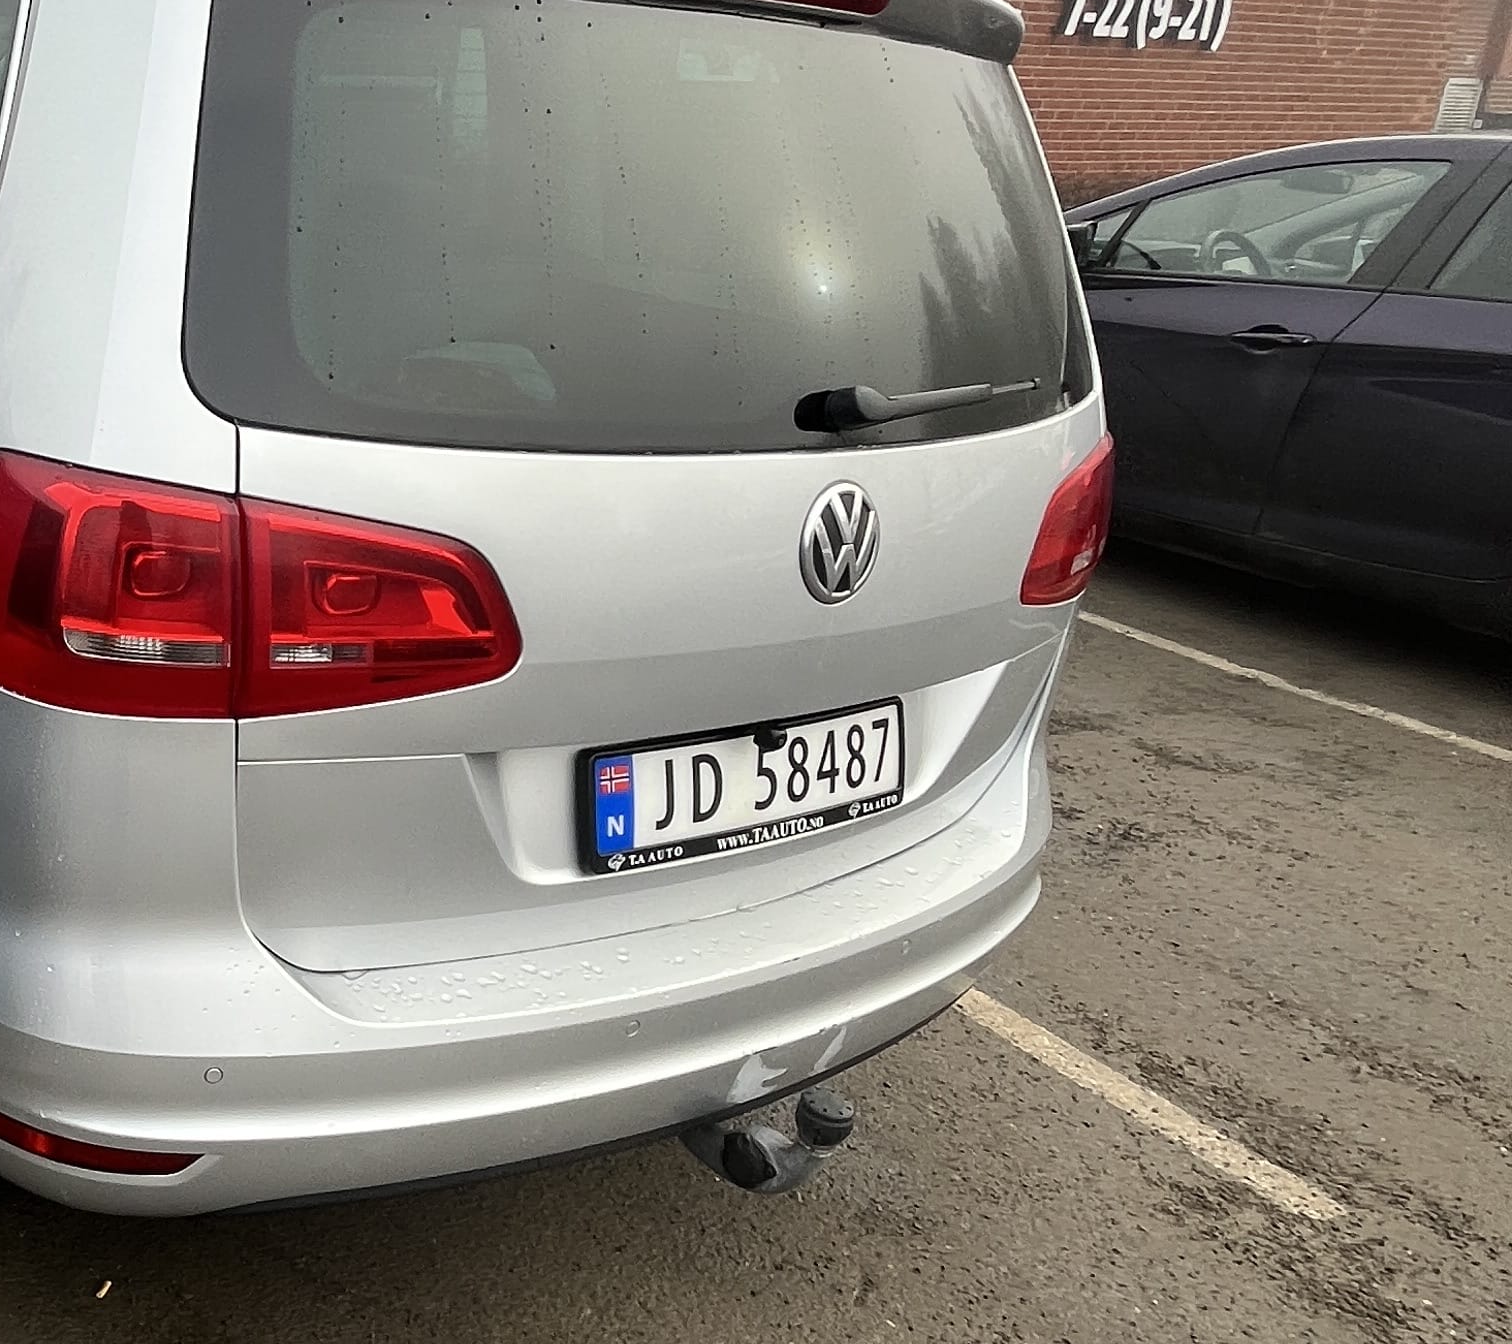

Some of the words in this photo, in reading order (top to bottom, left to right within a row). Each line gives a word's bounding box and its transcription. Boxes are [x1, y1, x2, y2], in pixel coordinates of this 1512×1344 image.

[655, 753, 723, 831] JD
[754, 718, 889, 811] 58487
[607, 814, 625, 838] N
[648, 846, 684, 863] AUTO
